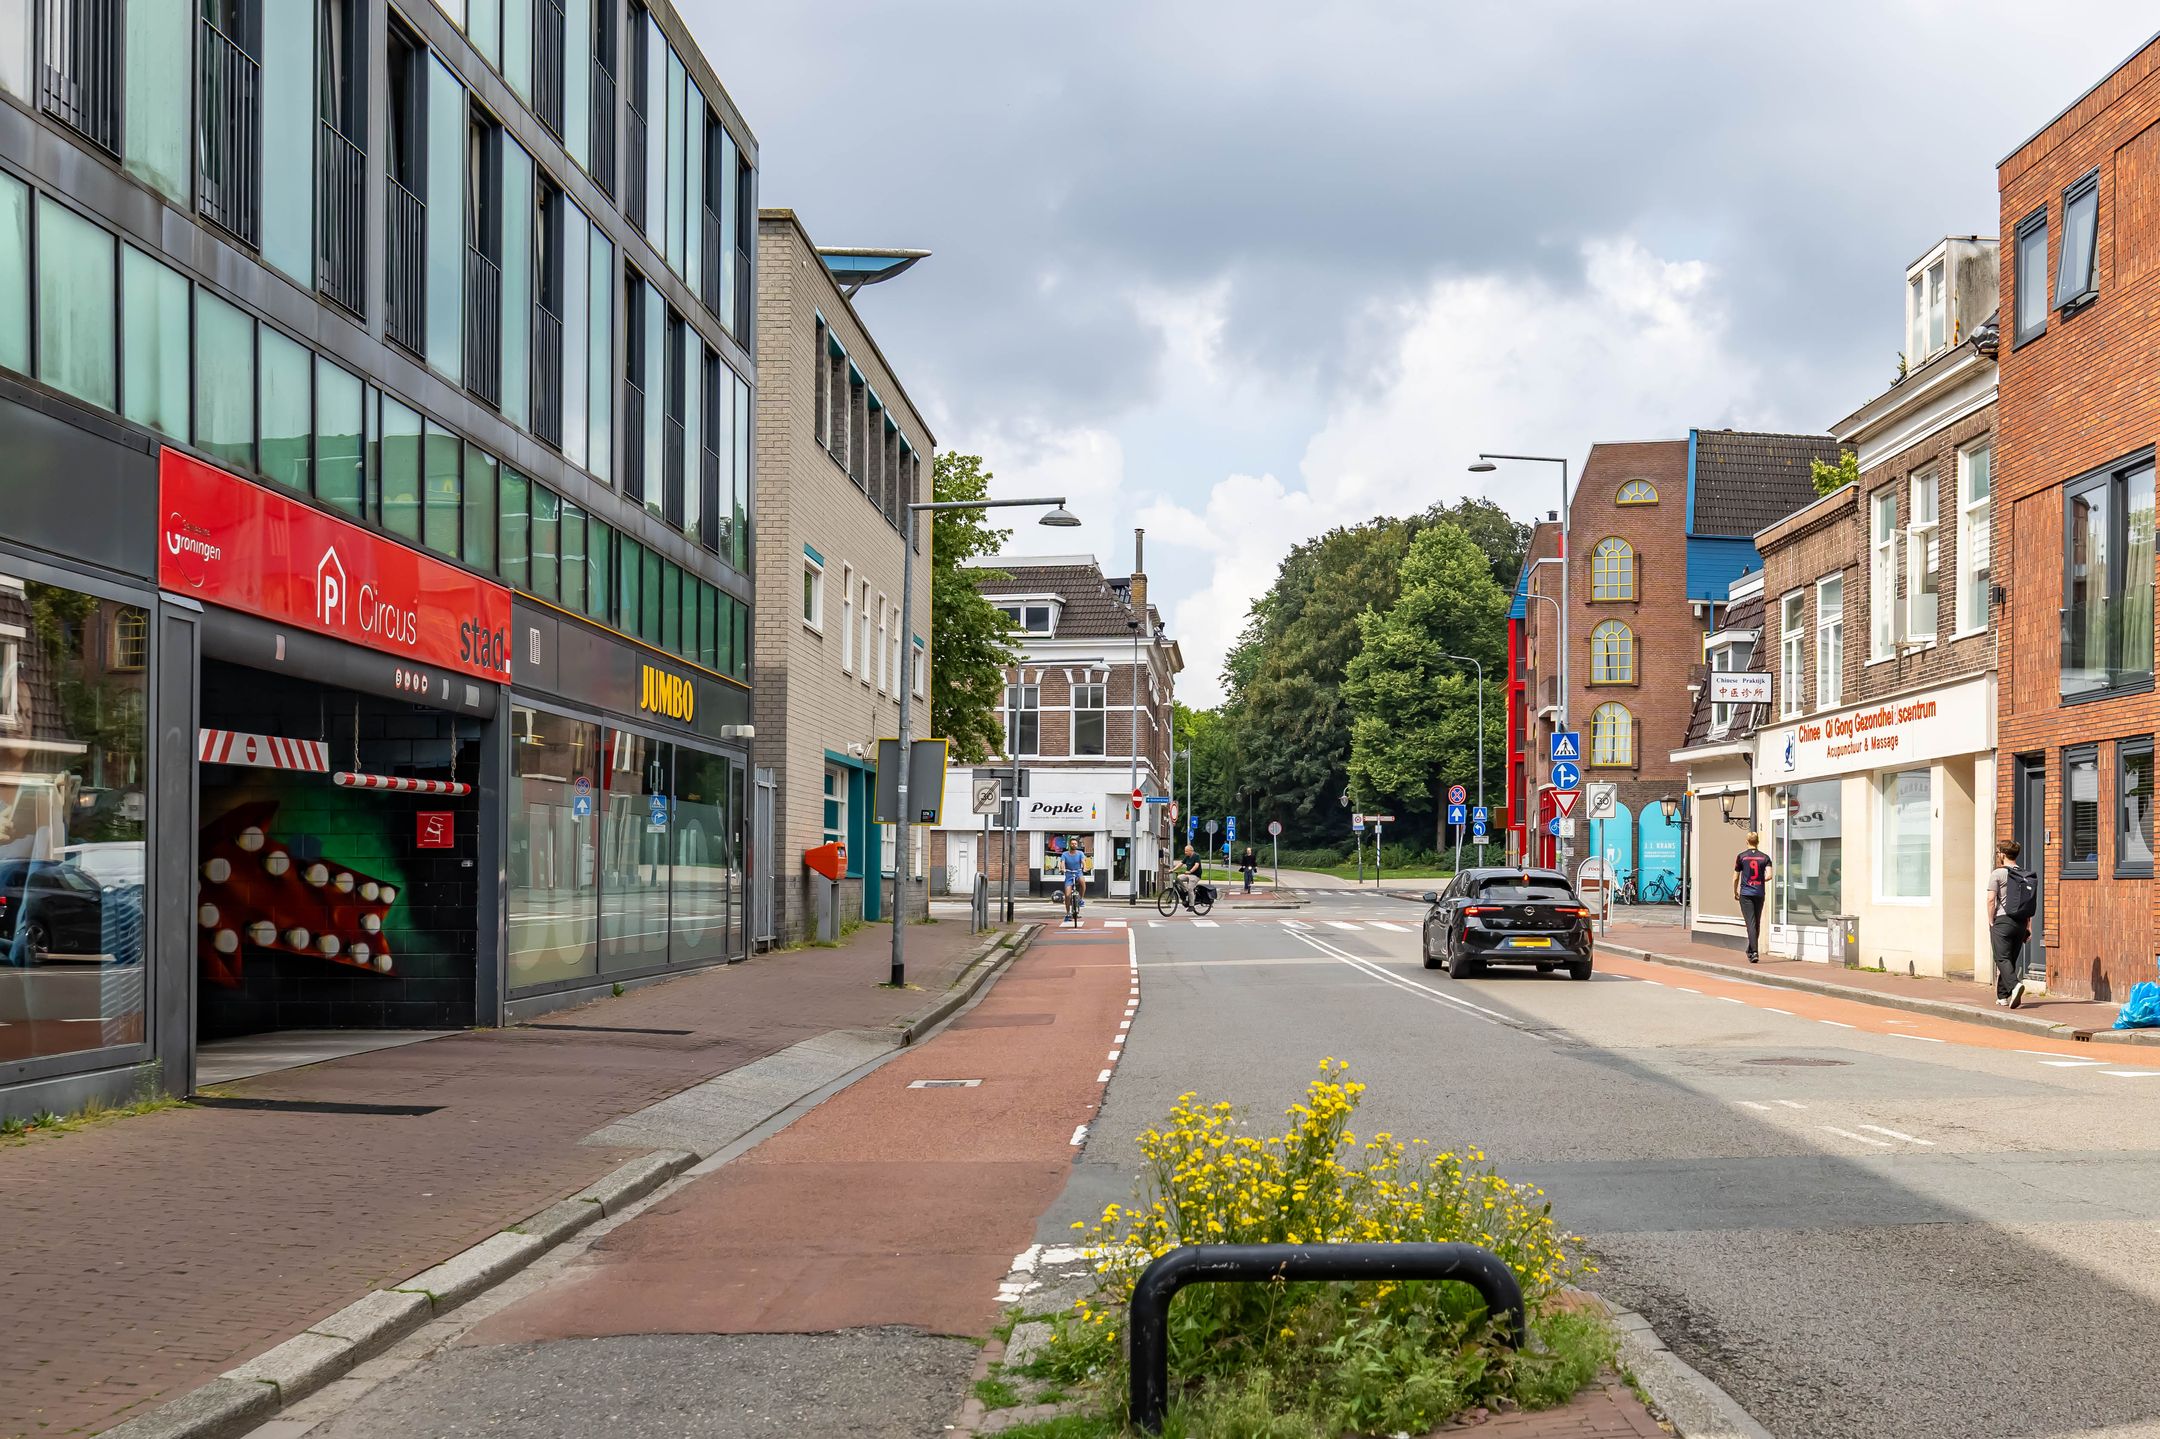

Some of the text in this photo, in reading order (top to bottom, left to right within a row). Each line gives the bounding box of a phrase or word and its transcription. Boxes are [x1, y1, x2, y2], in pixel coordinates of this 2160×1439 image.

[166, 531, 222, 562] Groningen
[325, 575, 417, 645] P Circus
[460, 616, 511, 674] stad.
[1742, 677, 1766, 685] Praktijk
[640, 664, 694, 723] JUMBO
[1719, 686, 1764, 698] 中医诊所
[1825, 718, 1833, 738] Qi
[1834, 717, 1853, 738] Gong
[1864, 737, 1869, 751] &
[1871, 735, 1899, 751] Massage
[980, 792, 994, 801] 30
[1596, 797, 1609, 806] 30
[1030, 802, 1084, 815] Popke
[1749, 860, 1759, 880] 9
